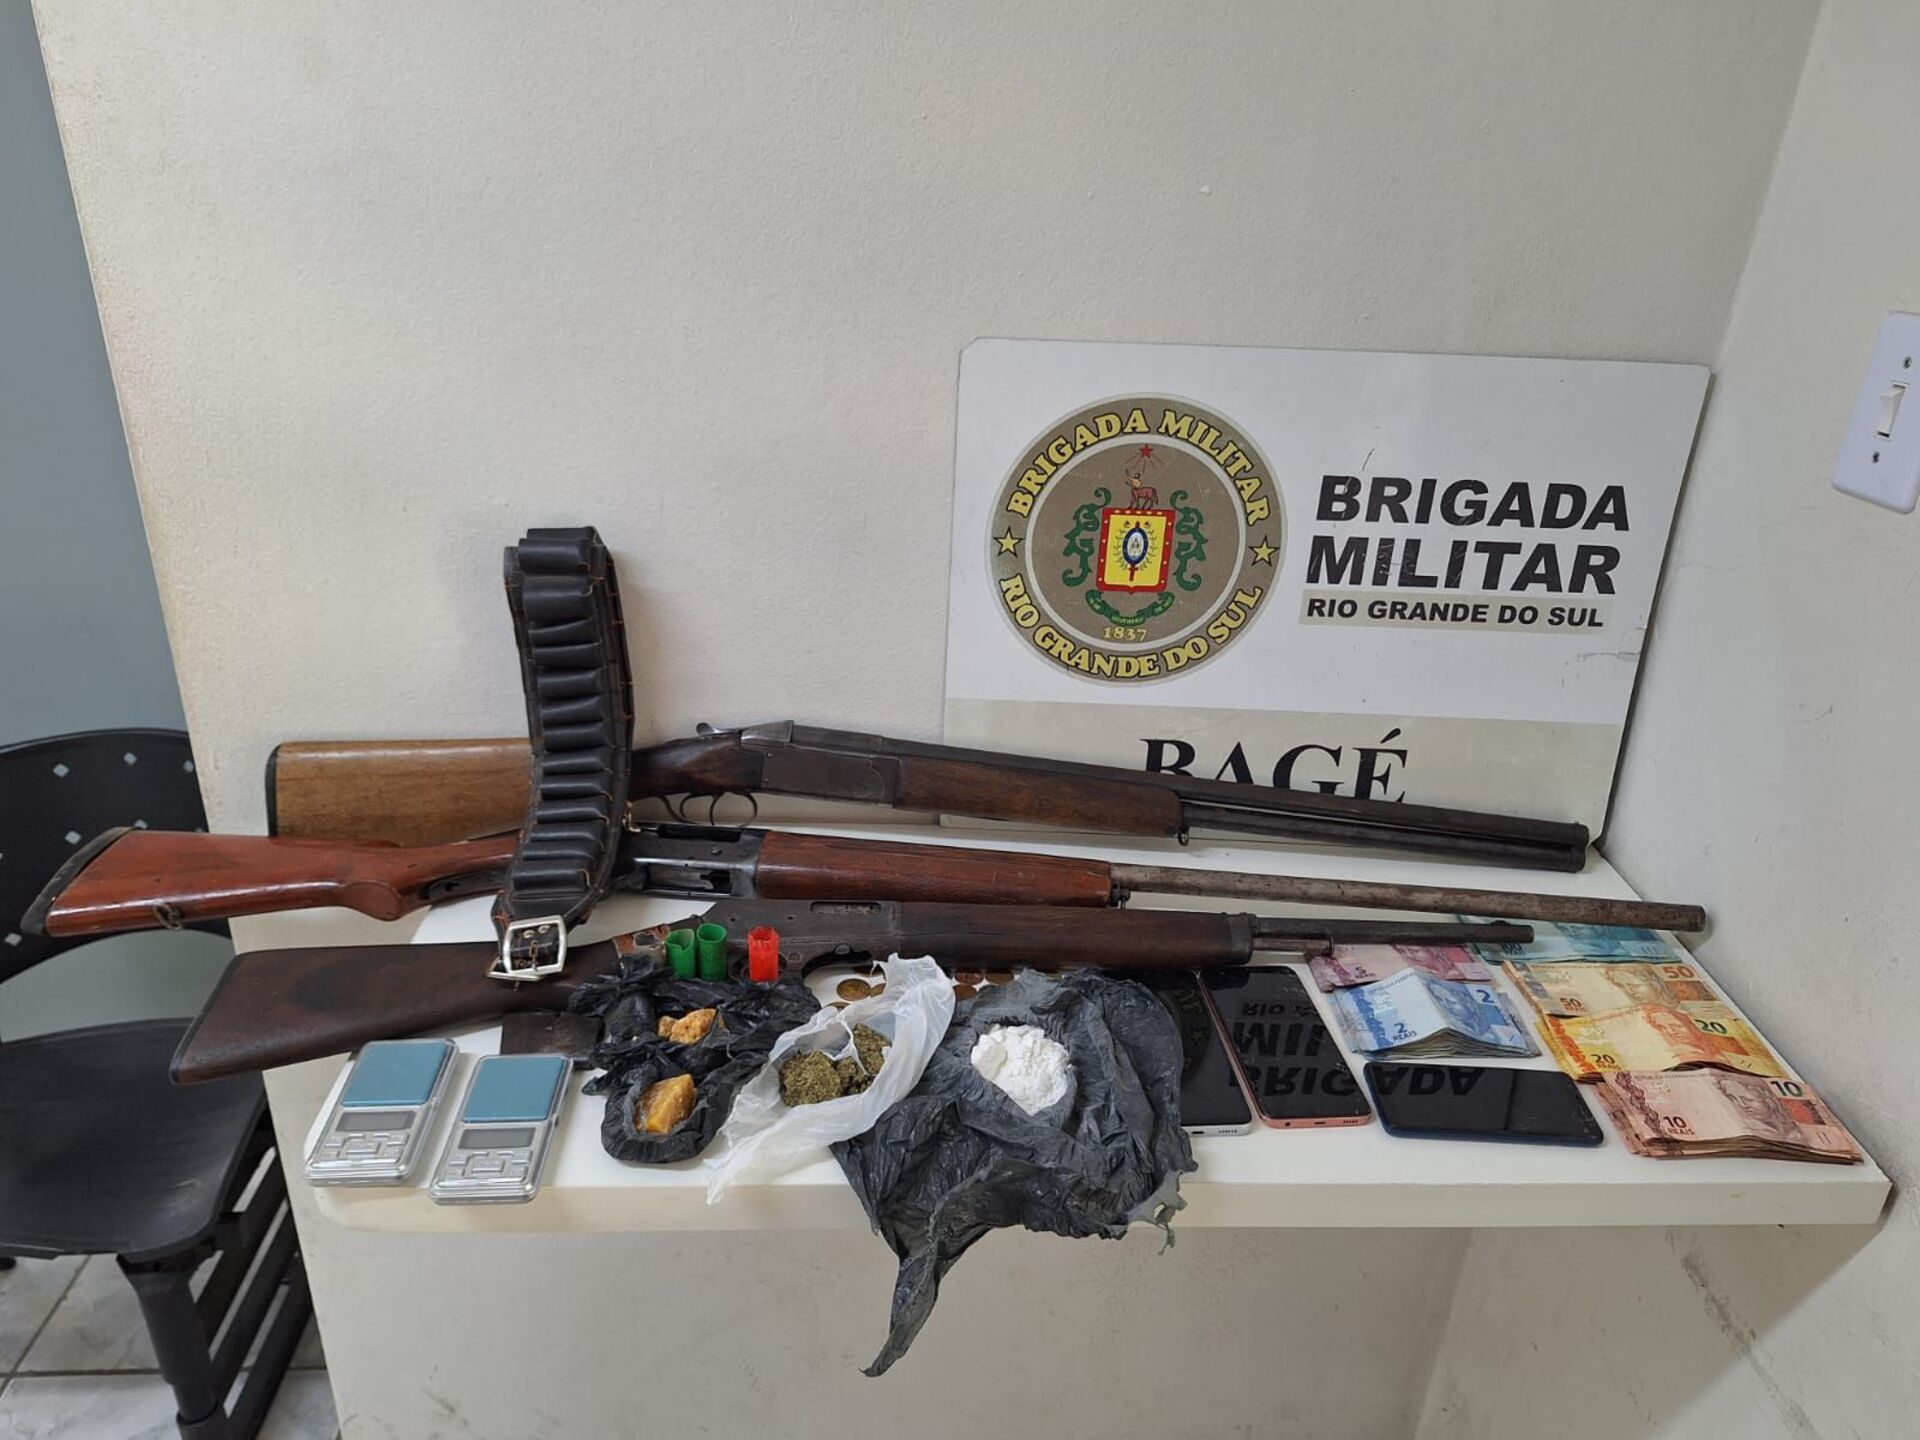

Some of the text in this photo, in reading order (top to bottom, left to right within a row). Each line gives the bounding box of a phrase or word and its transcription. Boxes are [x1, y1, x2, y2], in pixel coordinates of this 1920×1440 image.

[1006, 408, 1271, 526] BRIGADA MILITAR
[1316, 475, 1630, 531] BRIGADA
[1306, 535, 1620, 594] MILITAR
[1307, 598, 1603, 627] RIO GRANDE DO SUL
[999, 574, 1263, 678] RIO GRANDE DO SUL
[1103, 626, 1147, 641] 1837
[1662, 966, 1694, 979] 50
[1477, 990, 1495, 1003] 2
[1560, 998, 1582, 1007] 50
[1394, 1022, 1407, 1034] 2
[1695, 1019, 1728, 1034] 20
[1590, 1054, 1616, 1064] 20
[1770, 1080, 1803, 1097] 10
[1663, 1116, 1687, 1128] 10
